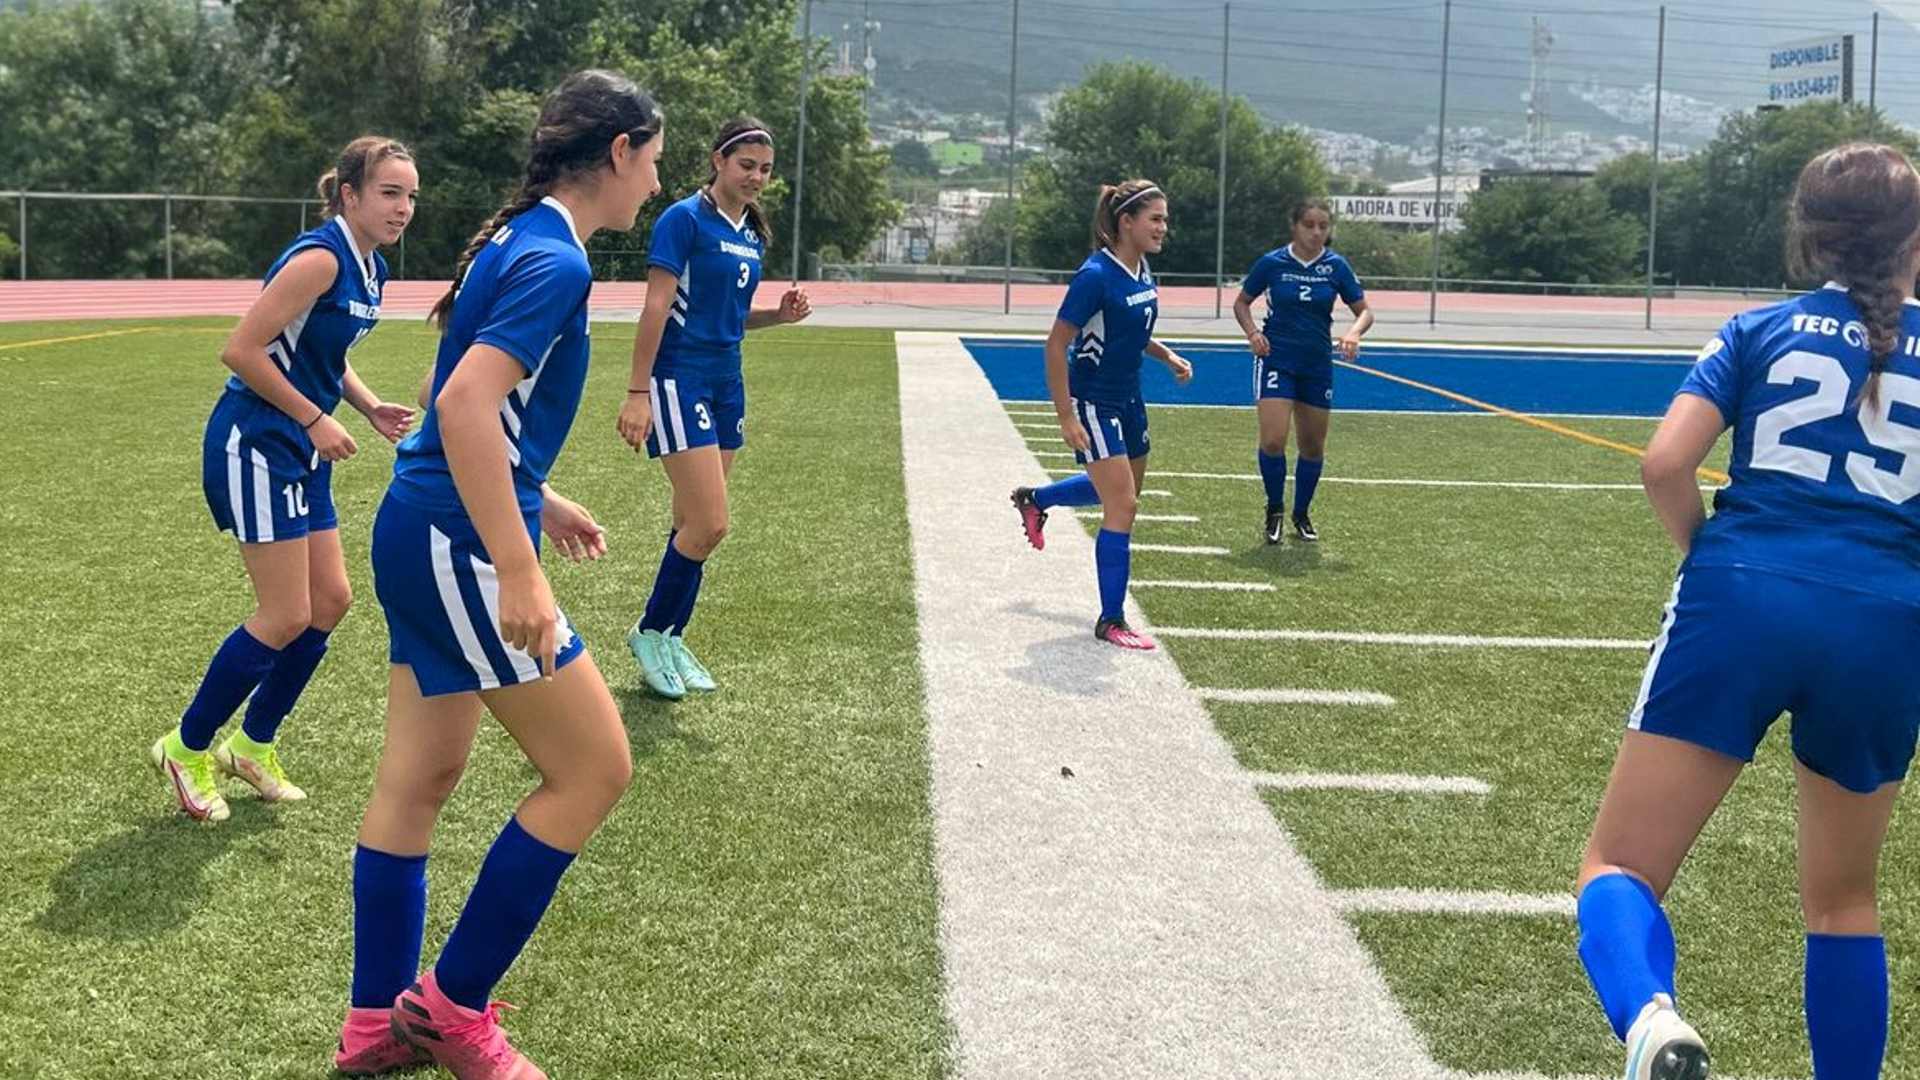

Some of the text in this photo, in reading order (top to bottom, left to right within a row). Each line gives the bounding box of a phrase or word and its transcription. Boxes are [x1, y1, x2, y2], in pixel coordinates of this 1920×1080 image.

[1770, 43, 1840, 69] DISPONIBLE
[1400, 201, 1418, 217] DE
[737, 262, 750, 289] 3
[1300, 286, 1312, 301] 2
[1144, 307, 1154, 330] 7
[1792, 314, 1840, 336] TEC
[1267, 371, 1279, 389] 2
[694, 403, 711, 430] 3
[1749, 350, 1920, 505] 25
[1109, 417, 1123, 441] 7
